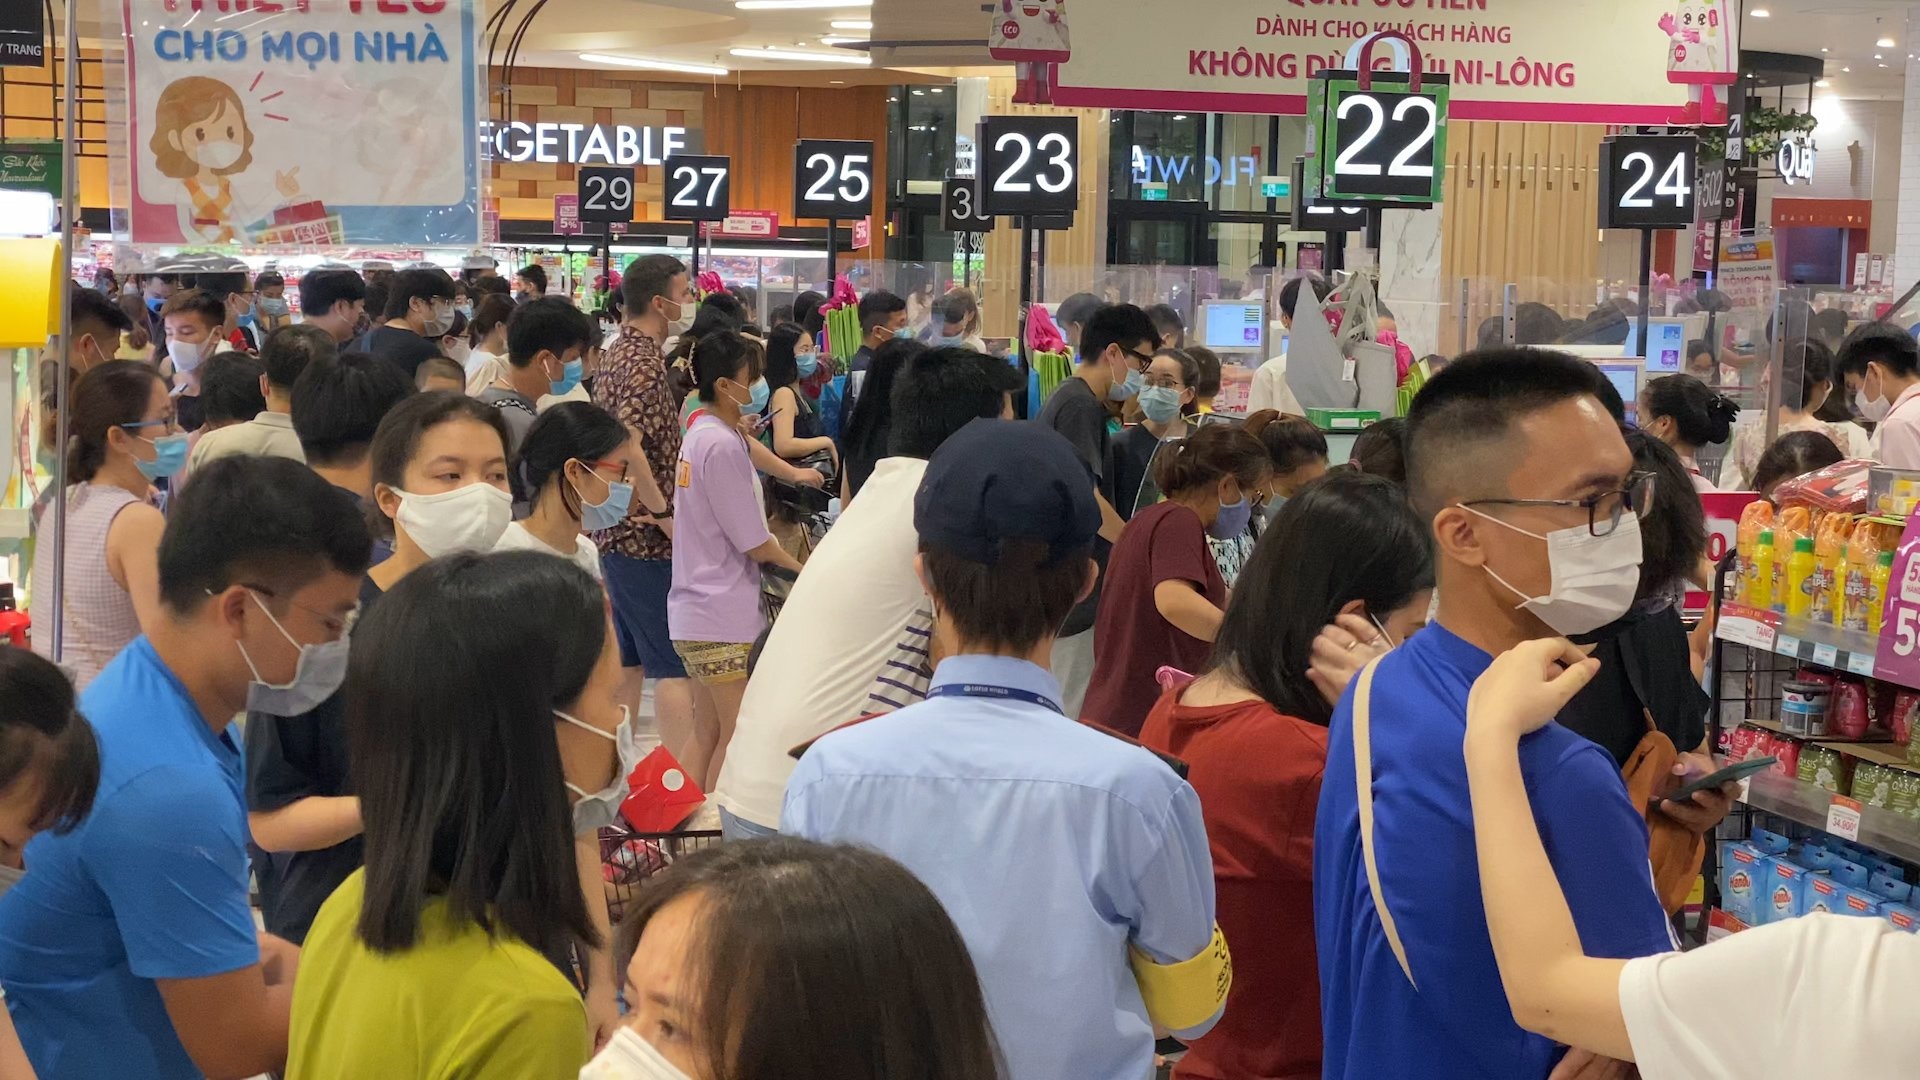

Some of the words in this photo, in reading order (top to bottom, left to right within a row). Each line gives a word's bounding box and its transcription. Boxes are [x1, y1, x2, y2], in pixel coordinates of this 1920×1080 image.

[7, 43, 42, 57] TRANG
[154, 29, 248, 62] CHO
[262, 30, 340, 71] MỌI
[355, 22, 449, 63] NHÀ
[1256, 14, 1317, 37] DÀNH
[1323, 20, 1368, 38] CHO
[1451, 21, 1511, 44] HÀNG
[1189, 46, 1298, 79] KHÔNG
[1454, 56, 1575, 88] NI-LÔNG
[1335, 95, 1436, 176] 22
[804, 153, 869, 202] 25
[993, 132, 1073, 193] 23
[1619, 152, 1690, 208] 24
[584, 176, 632, 211] 29
[671, 166, 727, 207] 27
